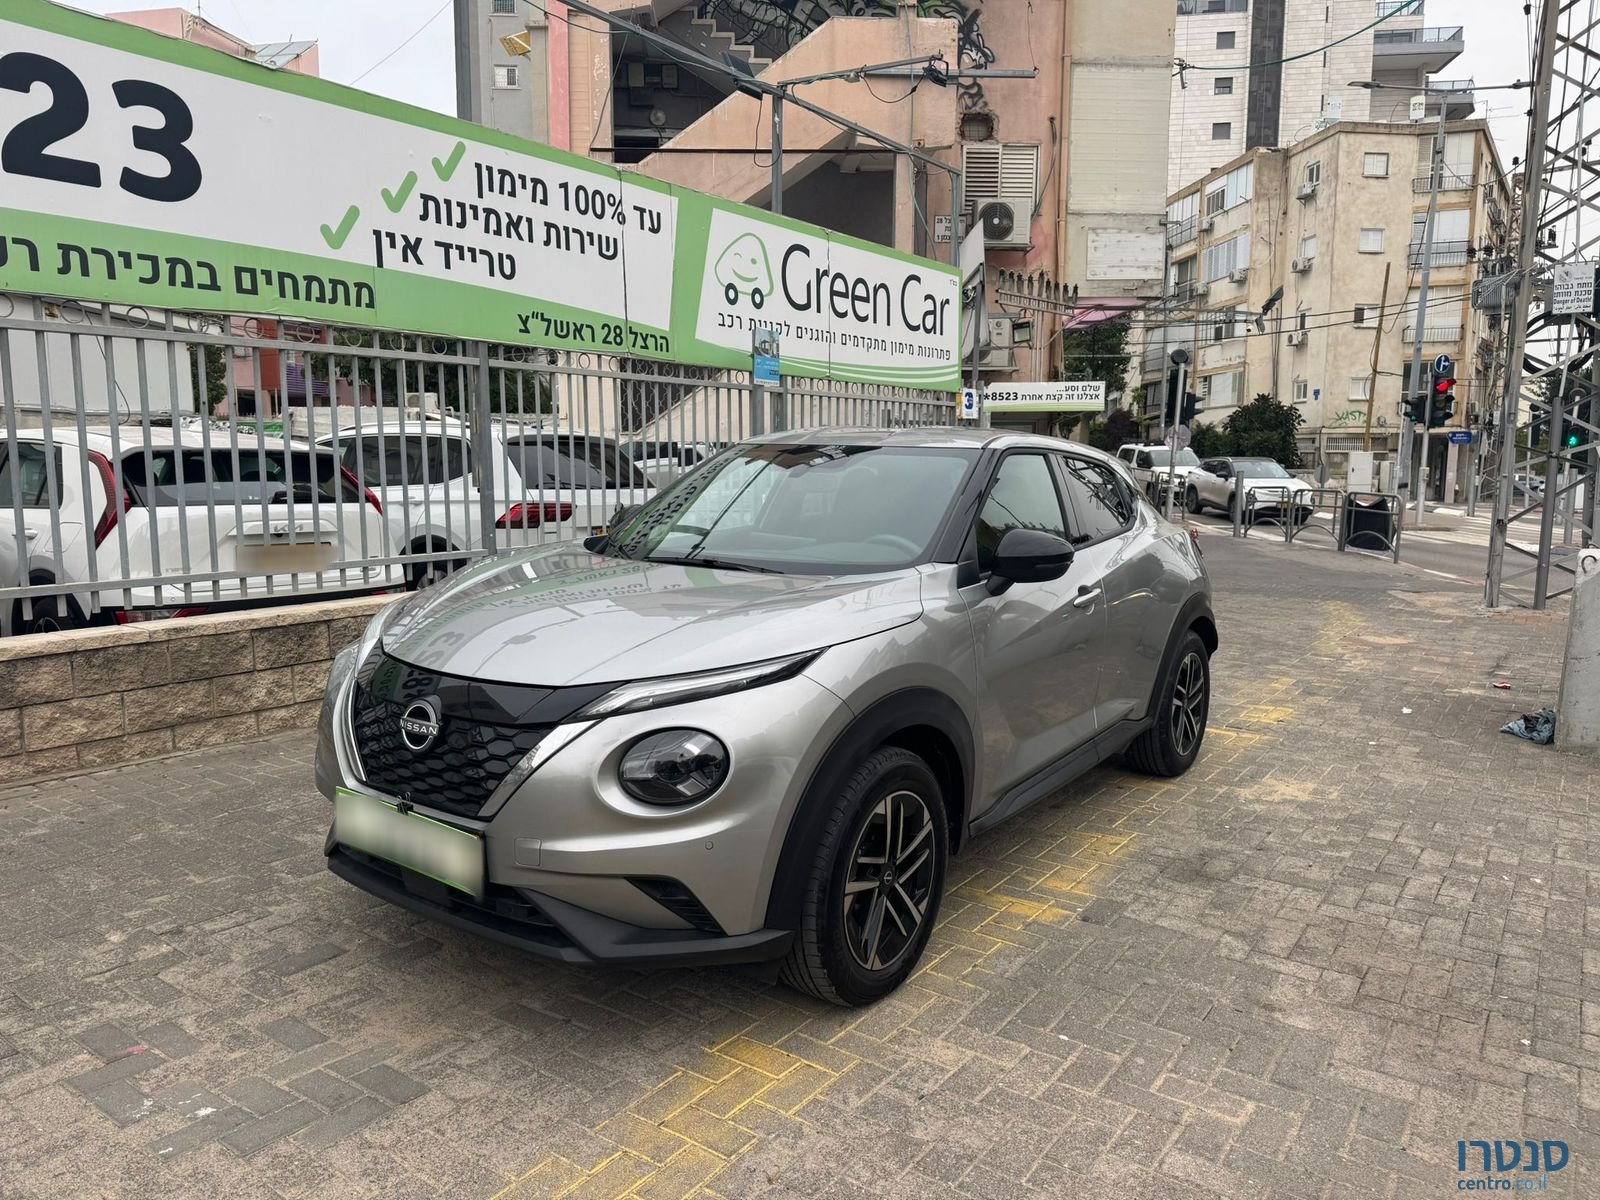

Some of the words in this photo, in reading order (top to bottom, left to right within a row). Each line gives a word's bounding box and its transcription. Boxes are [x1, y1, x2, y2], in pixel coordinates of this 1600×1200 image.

[0, 51, 203, 203] 23
[474, 162, 549, 206] מימון
[558, 180, 627, 227] 100%
[419, 192, 534, 245] ואמינות
[632, 205, 662, 236] עד
[372, 229, 424, 269] אין
[543, 220, 618, 261] שירות
[56, 242, 222, 296] במכירת
[434, 240, 516, 281] טרייד
[233, 265, 376, 310] מתמחים
[781, 243, 891, 328] Green
[900, 274, 951, 336] Car
[718, 311, 744, 331] רכב
[601, 323, 625, 348] 28
[628, 324, 671, 353] הרצל
[796, 326, 836, 345] והוגנים
[841, 333, 887, 353] מתקדמים
[890, 340, 915, 358] מימון
[917, 343, 952, 361] פתרונות
[1045, 393, 1063, 402] קצת
[1065, 393, 1075, 401] זה
[1076, 392, 1100, 400] אצלנו
[1081, 384, 1101, 392] שלם
[273, 523, 304, 533] KA
[399, 718, 438, 735] NISSAN
